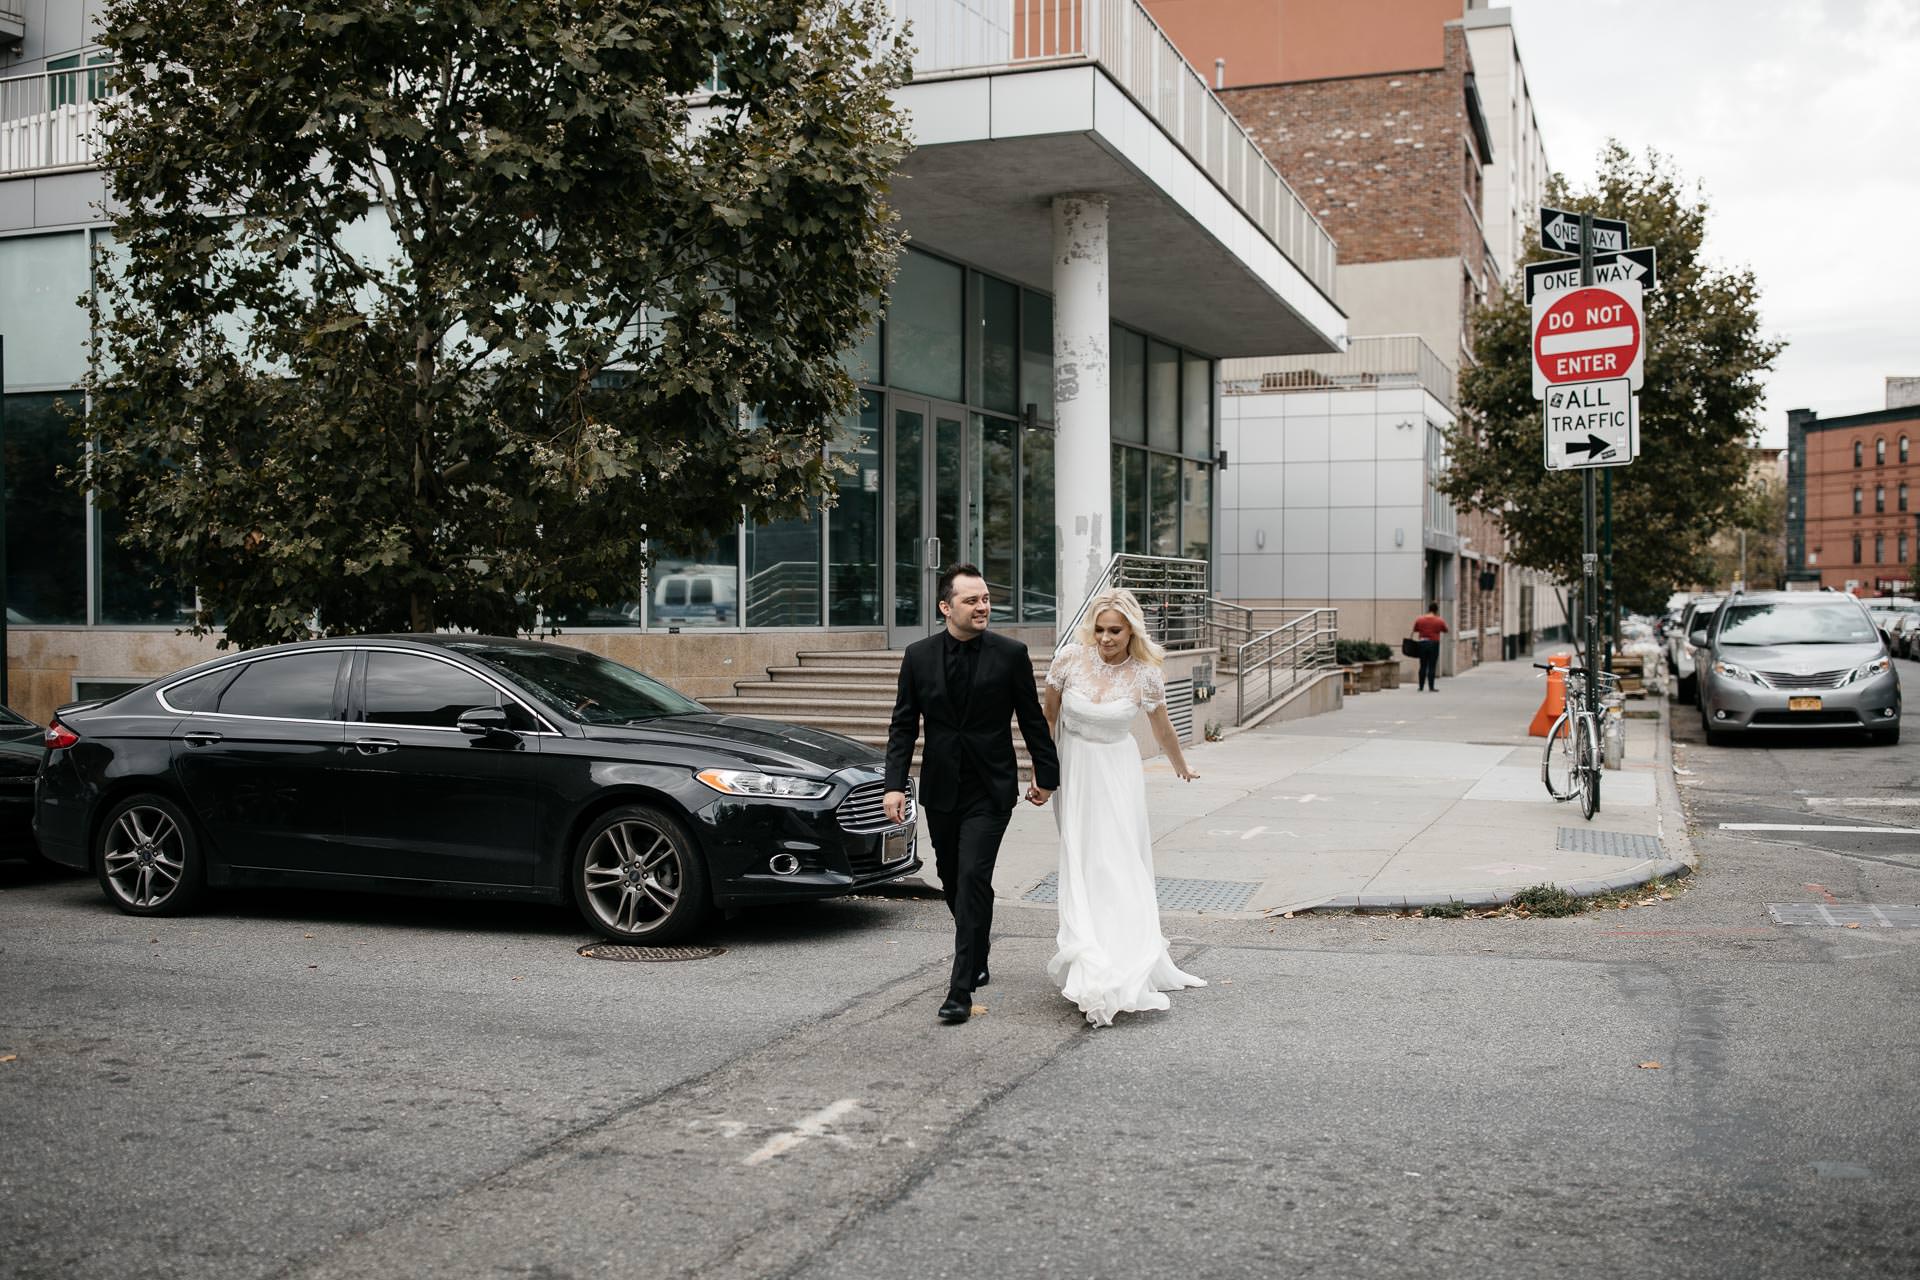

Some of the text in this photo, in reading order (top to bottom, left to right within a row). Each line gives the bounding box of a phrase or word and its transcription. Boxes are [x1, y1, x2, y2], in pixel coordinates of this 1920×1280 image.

[1553, 223, 1577, 242] ONE
[1543, 263, 1634, 290] ONE WAY
[1549, 304, 1624, 330] DO NOT
[1556, 353, 1617, 376] ENTER
[1566, 387, 1611, 409] ALL
[1551, 411, 1625, 432] TRAFFIC
